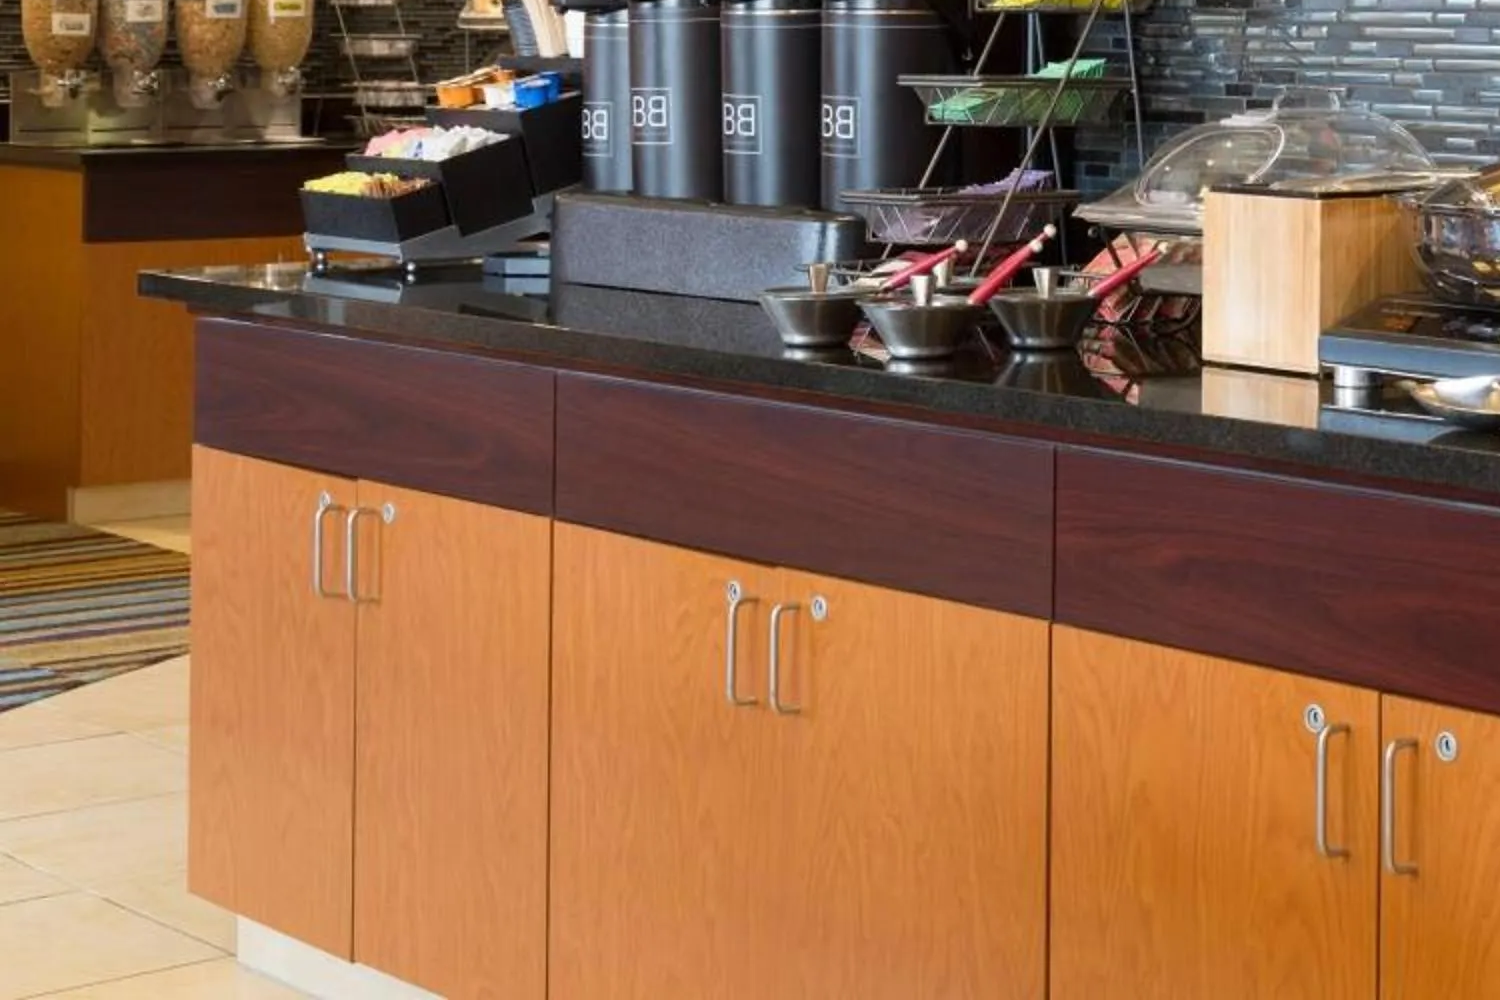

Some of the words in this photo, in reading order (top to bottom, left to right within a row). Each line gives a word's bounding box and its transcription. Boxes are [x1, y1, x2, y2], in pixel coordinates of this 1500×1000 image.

[632, 96, 667, 127] BB
[723, 103, 755, 136] BB
[822, 104, 854, 138] BB
